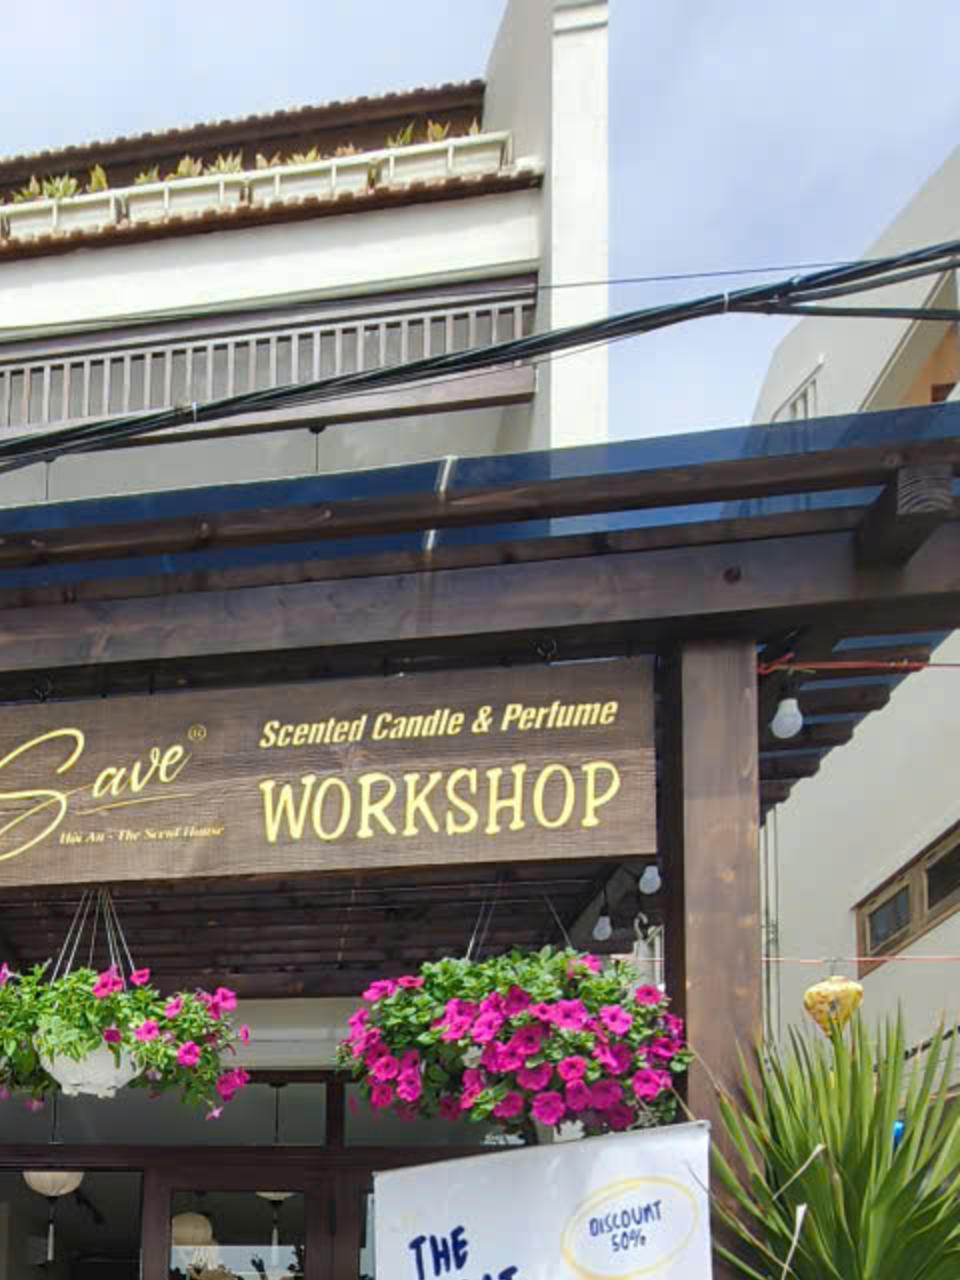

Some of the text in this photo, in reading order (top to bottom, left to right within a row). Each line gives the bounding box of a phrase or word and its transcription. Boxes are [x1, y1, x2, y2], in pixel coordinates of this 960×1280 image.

[259, 699, 618, 748] Scented Candle & Perfume
[259, 760, 621, 843] WORKSHOP
[117, 829, 141, 841] The
[143, 827, 180, 841] Scent
[182, 825, 225, 839] House
[589, 1200, 662, 1237] DISCOUNT
[611, 1229, 646, 1252] 50%
